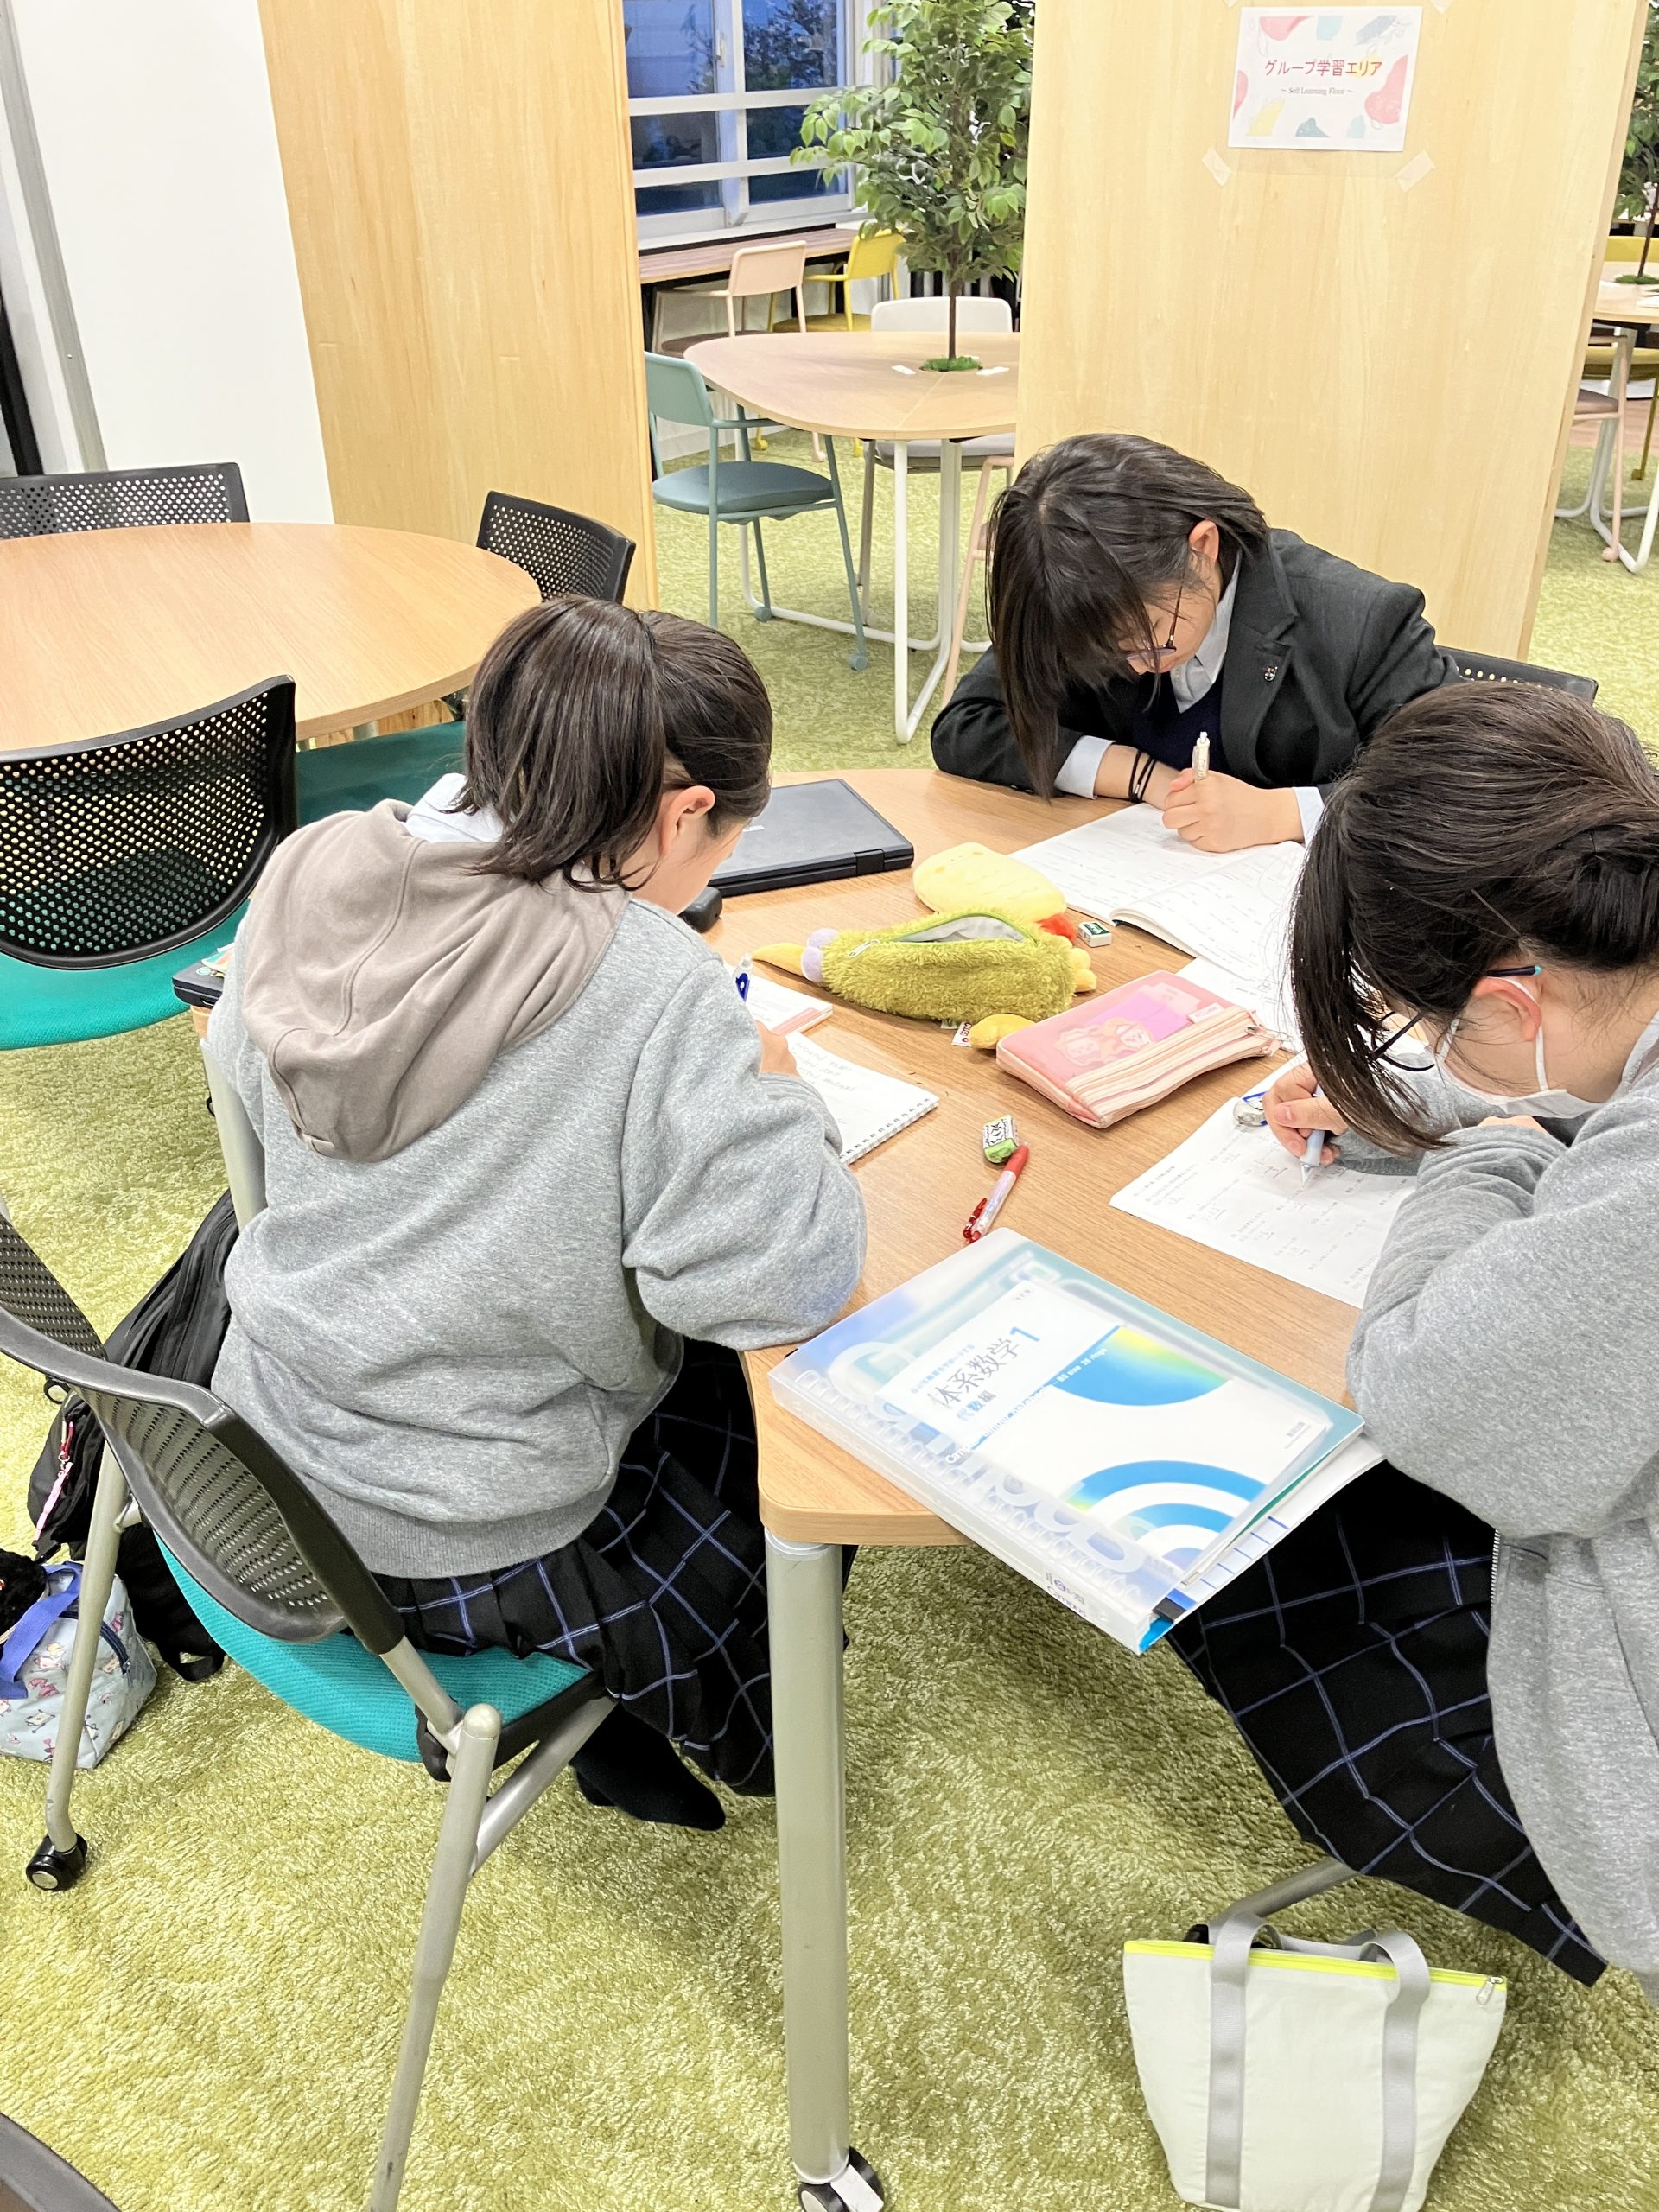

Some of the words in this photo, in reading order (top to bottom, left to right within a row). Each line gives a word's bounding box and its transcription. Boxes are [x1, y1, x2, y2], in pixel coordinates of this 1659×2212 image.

[1264, 59, 1382, 76] グループ学習エリア
[1301, 87, 1327, 96] Learning
